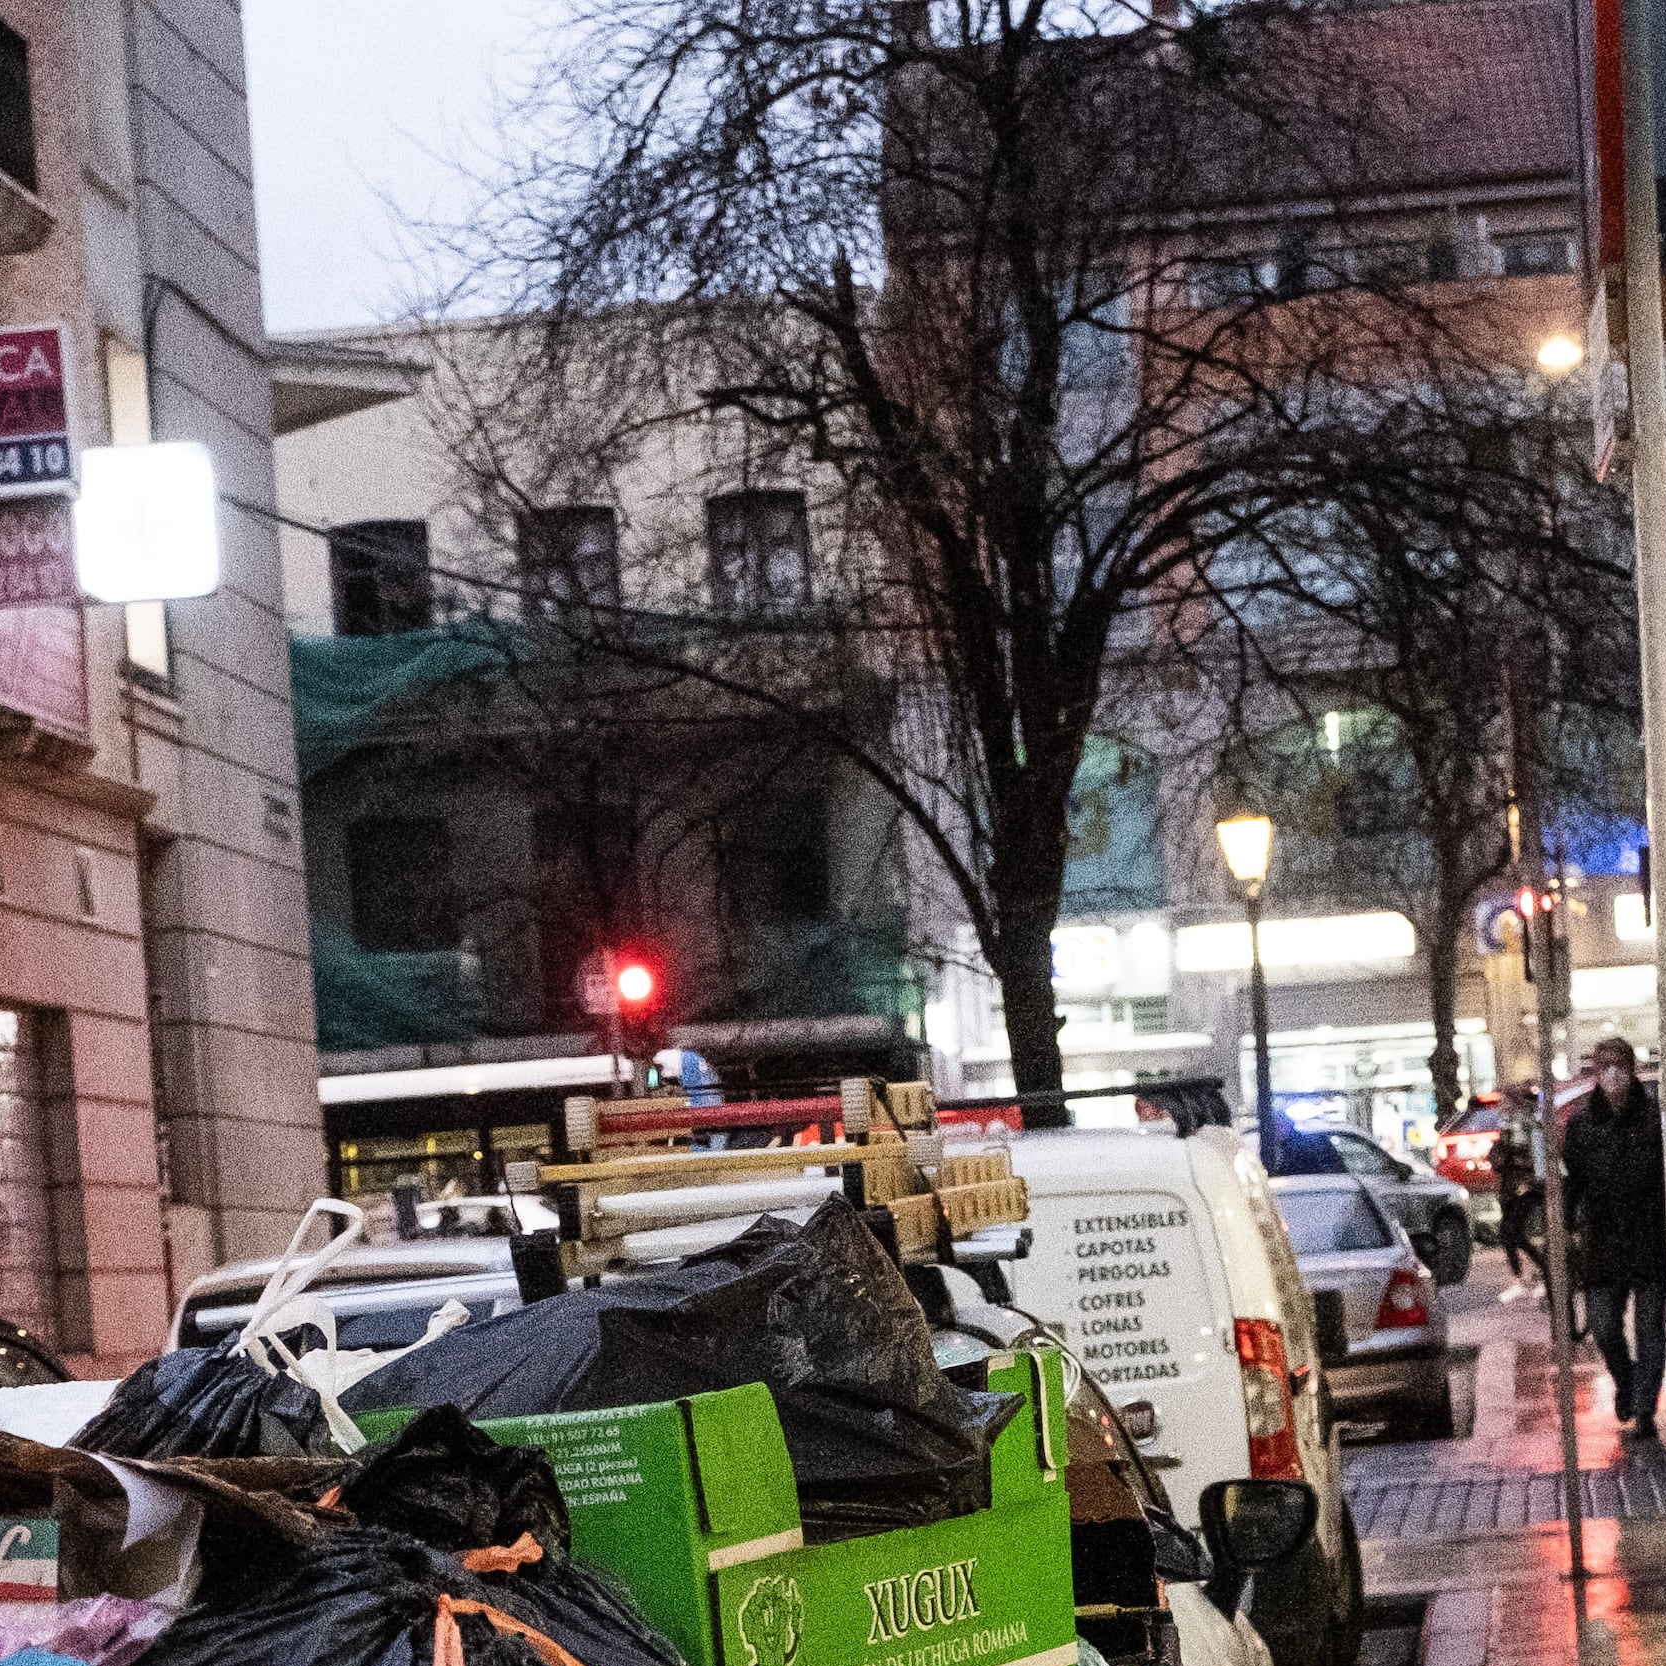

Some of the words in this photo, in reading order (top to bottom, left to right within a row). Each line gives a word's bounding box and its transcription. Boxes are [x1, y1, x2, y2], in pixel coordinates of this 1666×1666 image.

[30, 444, 64, 472] 10
[1073, 1209, 1189, 1235] EXTENSIBLES
[1076, 1237, 1156, 1259] CAPOTAS
[1080, 1290, 1146, 1313] COFRES
[1082, 1315, 1144, 1337] LONAS
[1084, 1338, 1171, 1360] MOTORES
[864, 1558, 981, 1645] XUGUX
[973, 1621, 1029, 1662] ROMANA
